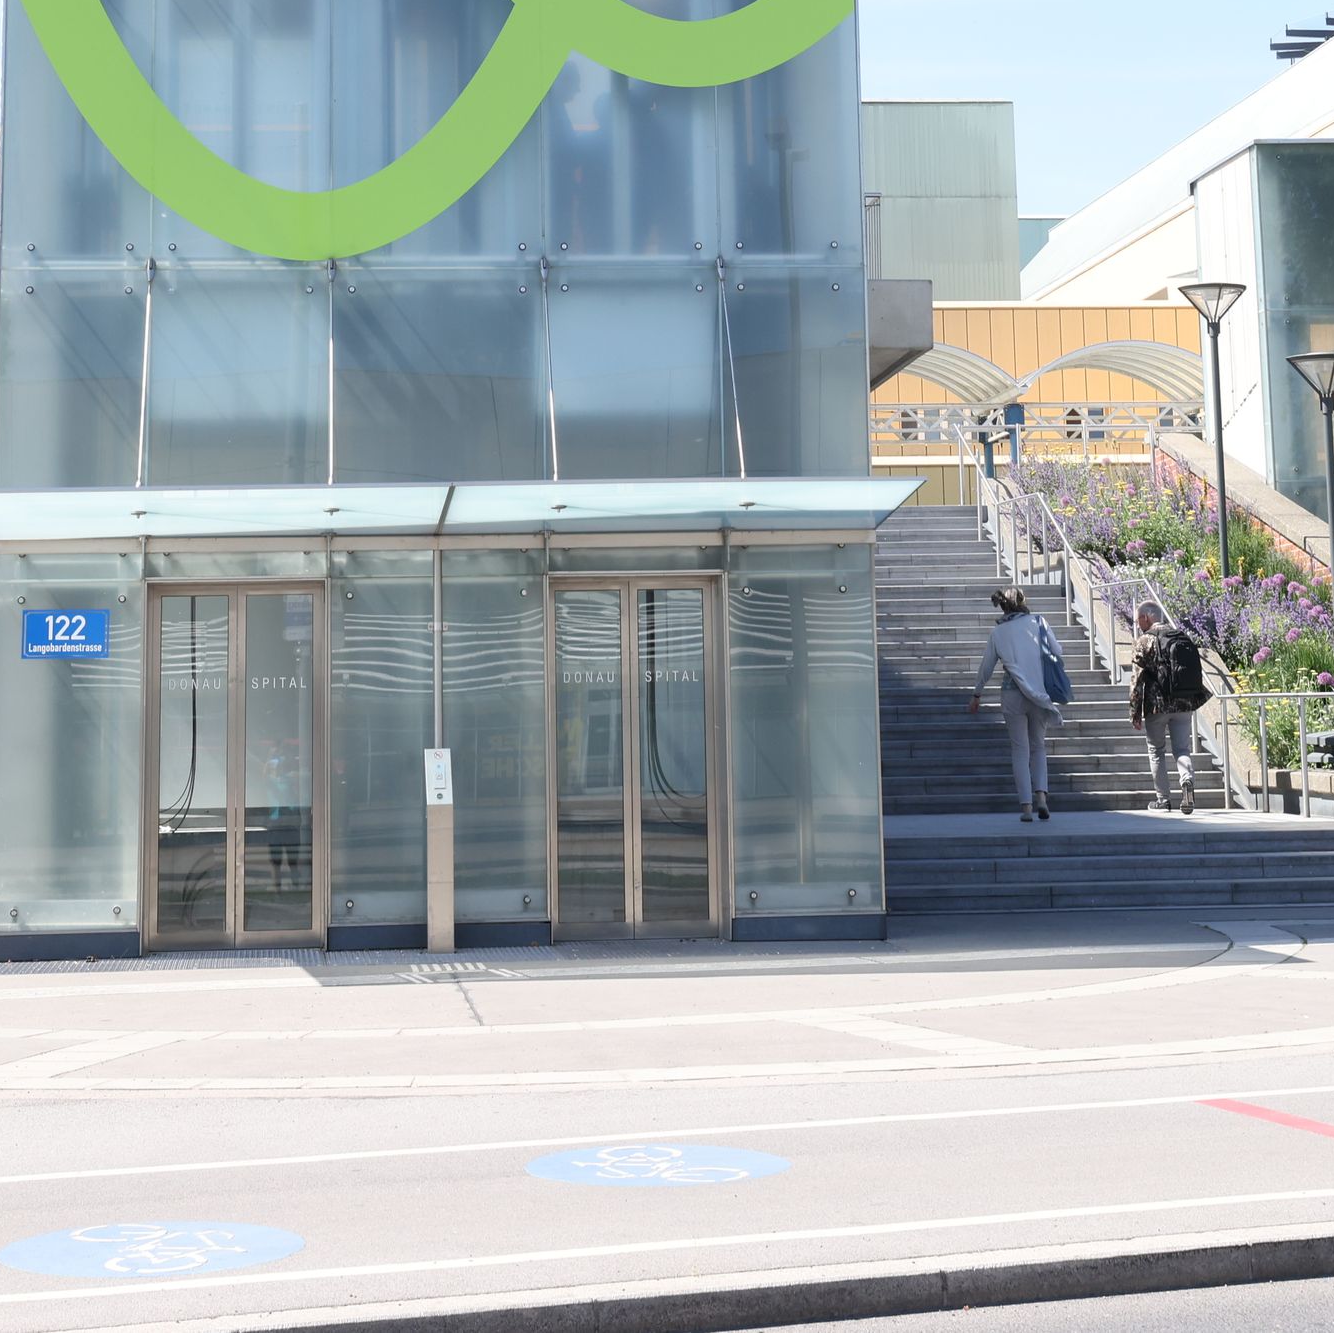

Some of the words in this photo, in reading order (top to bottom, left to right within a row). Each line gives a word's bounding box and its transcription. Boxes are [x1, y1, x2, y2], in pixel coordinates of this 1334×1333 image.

[45, 615, 86, 641] 122
[28, 643, 102, 655] Langobardenstrasse
[168, 677, 221, 691] DONAU
[251, 677, 307, 690] SPITAL
[563, 671, 615, 684] DONAU
[645, 670, 699, 683] SPITAL
